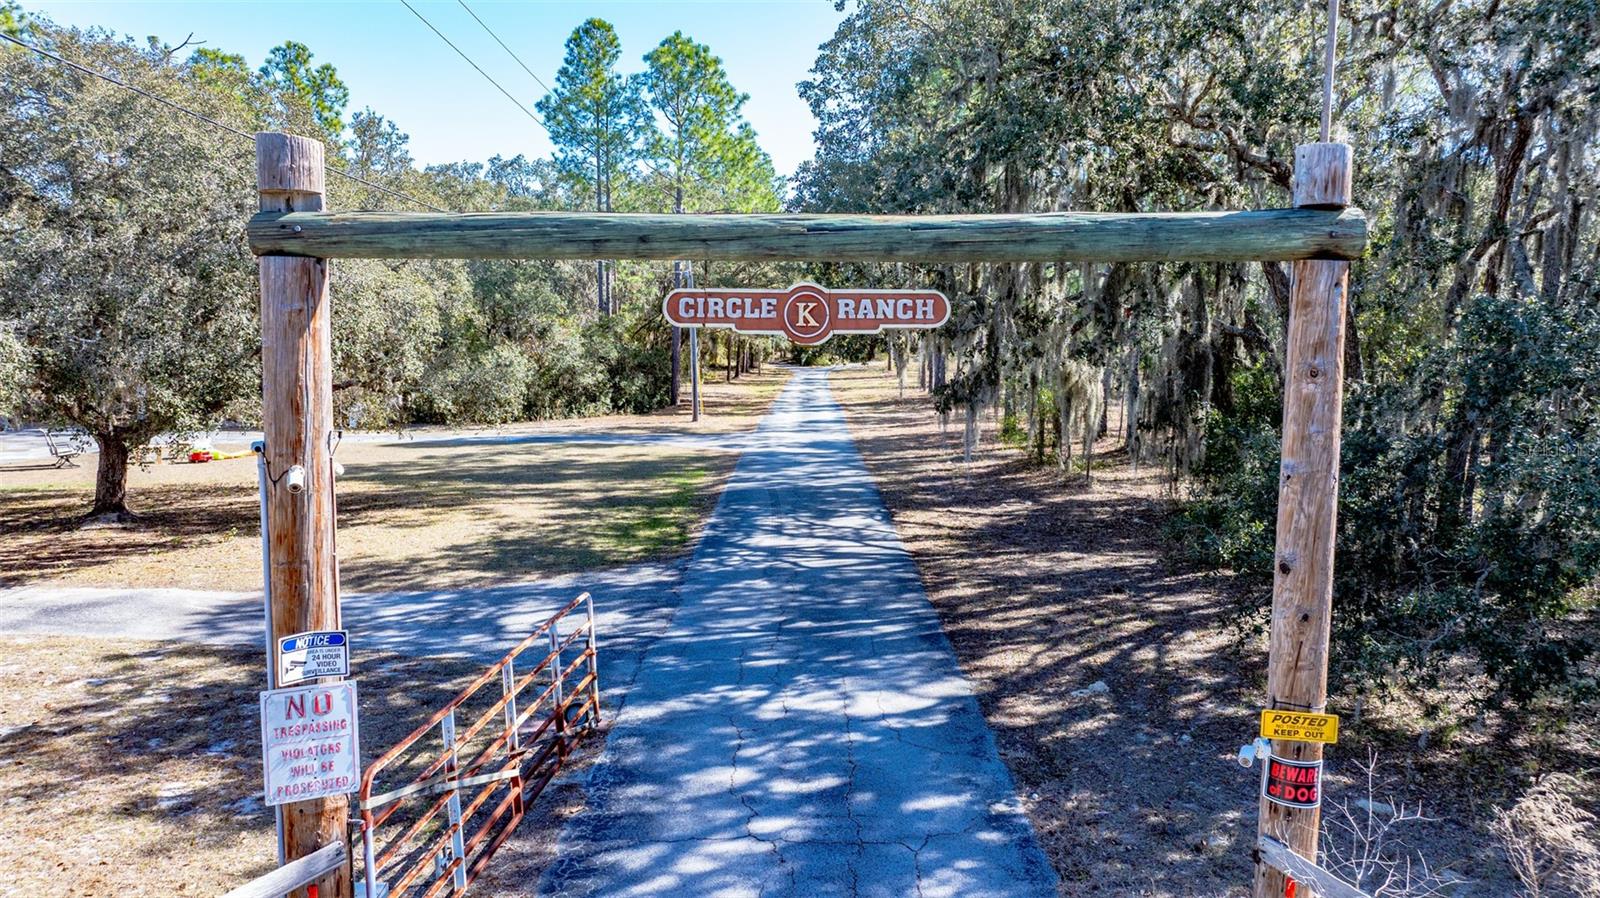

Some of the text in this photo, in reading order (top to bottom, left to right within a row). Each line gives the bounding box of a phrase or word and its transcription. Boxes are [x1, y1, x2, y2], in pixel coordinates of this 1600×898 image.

[678, 297, 935, 327] CIRCLE K RANCH
[295, 635, 330, 650] NOTICE
[316, 660, 337, 668] VIDEO
[285, 691, 333, 720] NO
[273, 719, 347, 739] TRESPASSING
[1272, 714, 1328, 727] POSTED
[1273, 729, 1325, 739] KEEP OUT
[281, 742, 342, 761] VIOLATORS
[290, 760, 335, 778] WILL BE
[1271, 762, 1319, 784] BEWARE
[277, 776, 349, 798] PROSECUTED
[1269, 785, 1317, 802] of DOG
